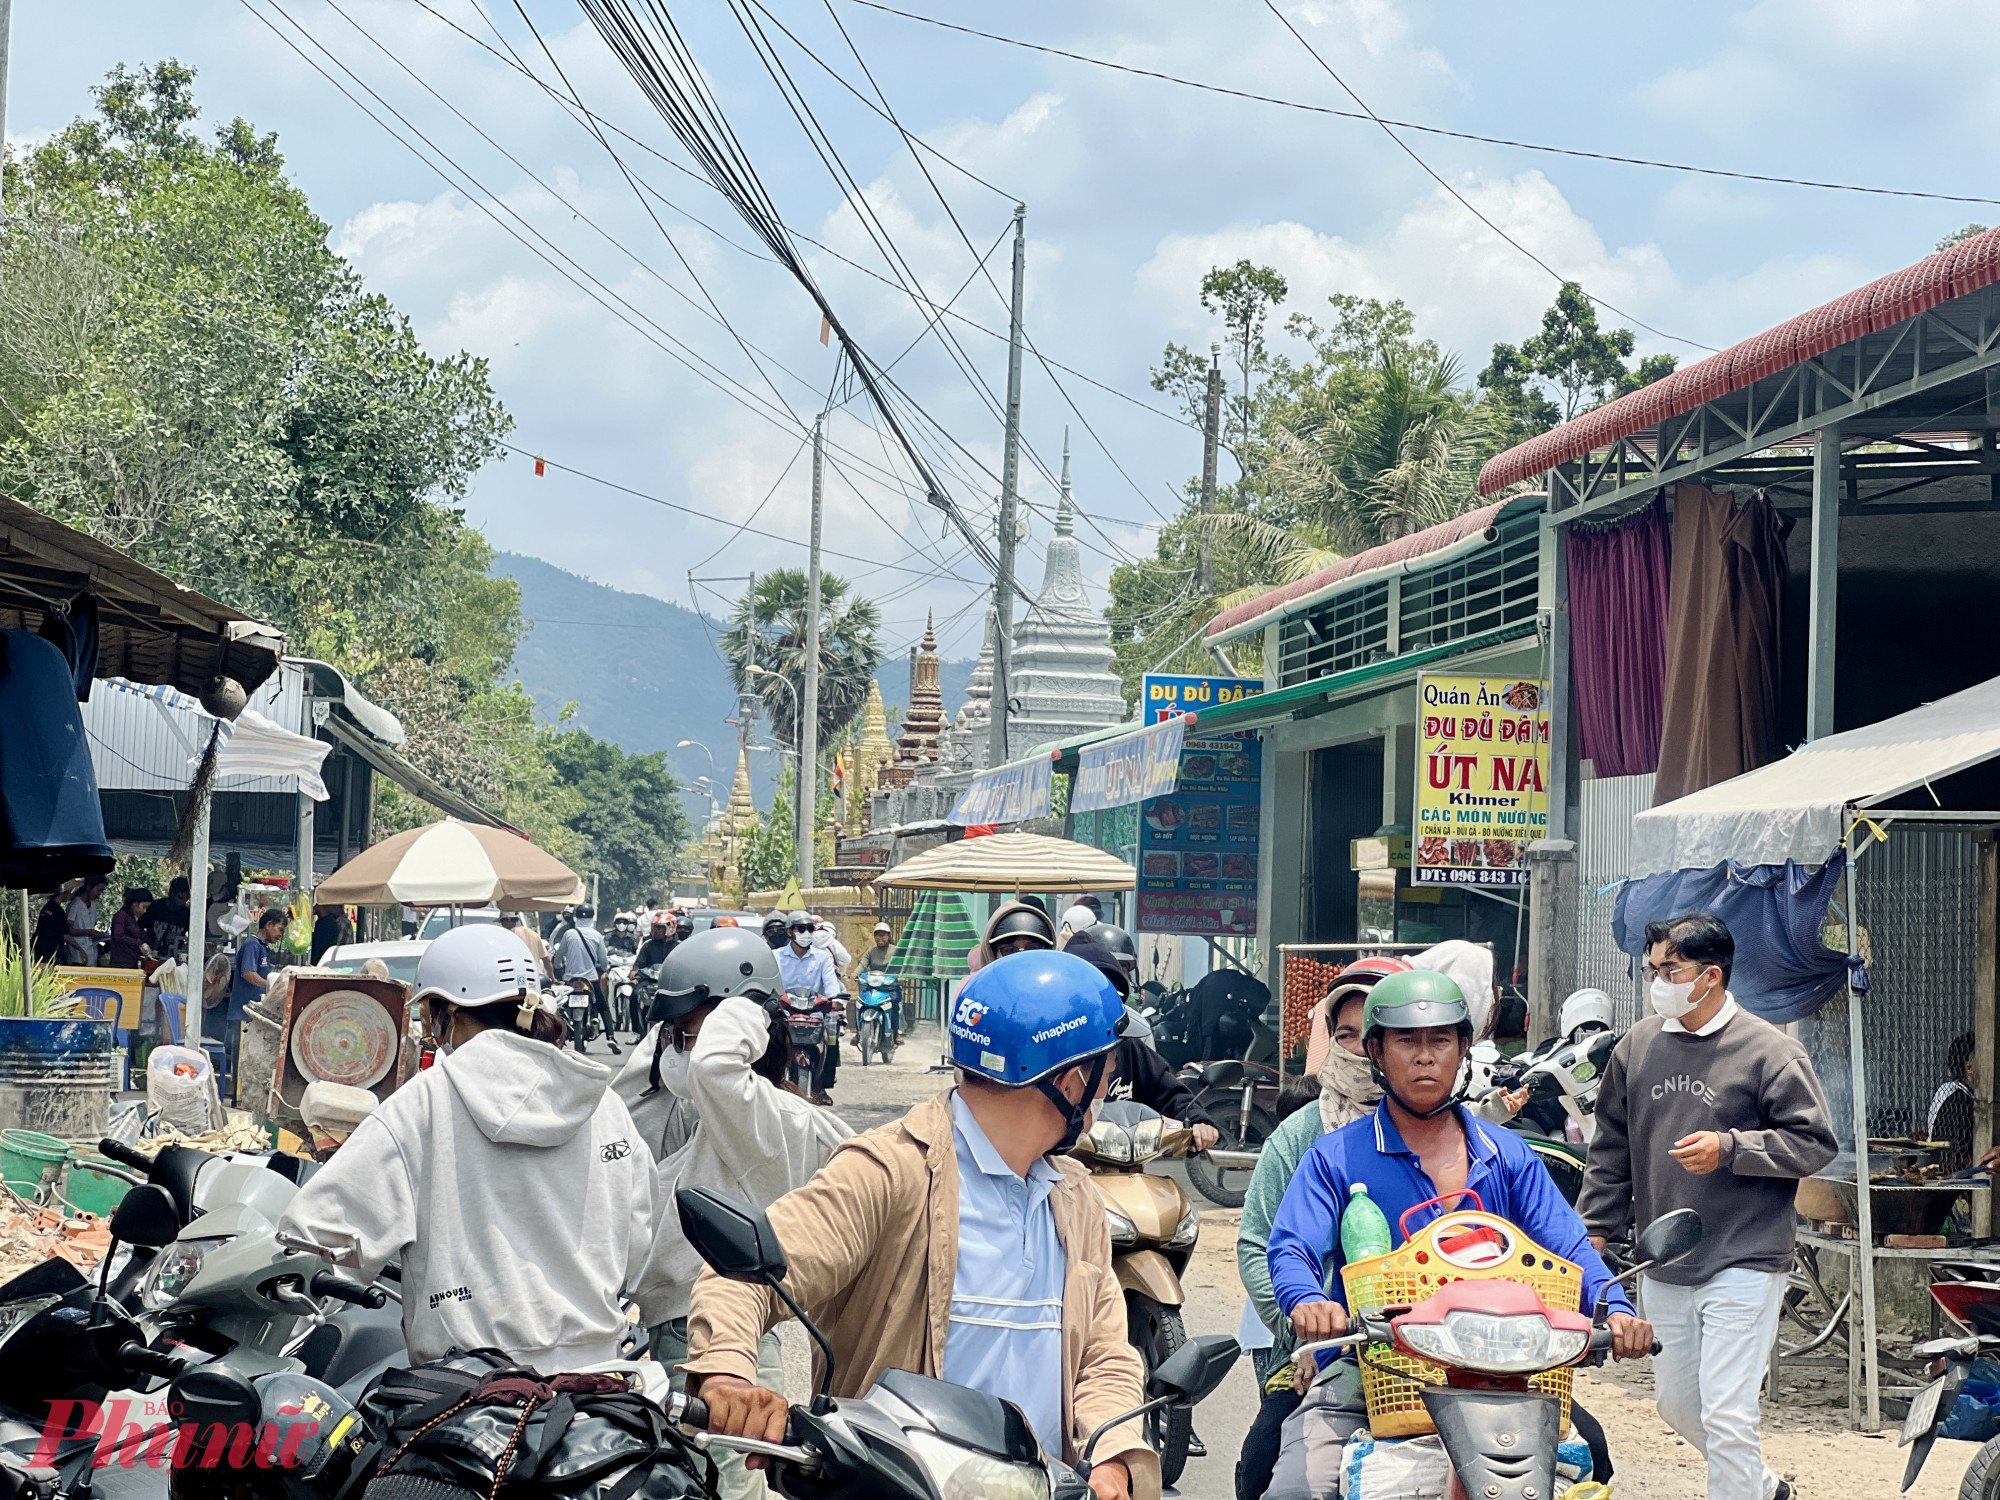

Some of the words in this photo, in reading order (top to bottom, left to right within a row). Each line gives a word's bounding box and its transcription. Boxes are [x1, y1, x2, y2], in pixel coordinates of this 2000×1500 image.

[1150, 685, 1178, 702] ĐU
[1184, 681, 1211, 702] ĐỦ
[1424, 684, 1470, 707] Quán
[1476, 681, 1500, 706] Ăn
[1424, 716, 1456, 739] ĐU
[1462, 711, 1494, 741] ĐỦ
[1426, 742, 1478, 790] ÚT
[1489, 755, 1544, 793] NA
[1449, 792, 1520, 806] Khmer
[1421, 806, 1451, 822] CÁC
[1457, 808, 1491, 823] MÓN
[1425, 824, 1441, 835] CHÂN
[1443, 825, 1451, 835] GÀ
[1468, 826, 1477, 836] GÀ
[1483, 827, 1491, 837] BÒ
[1530, 830, 1542, 839] QUE
[1449, 869, 1476, 882] 096
[1479, 870, 1506, 884] 843
[1031, 1015, 1088, 1043] vinaphone
